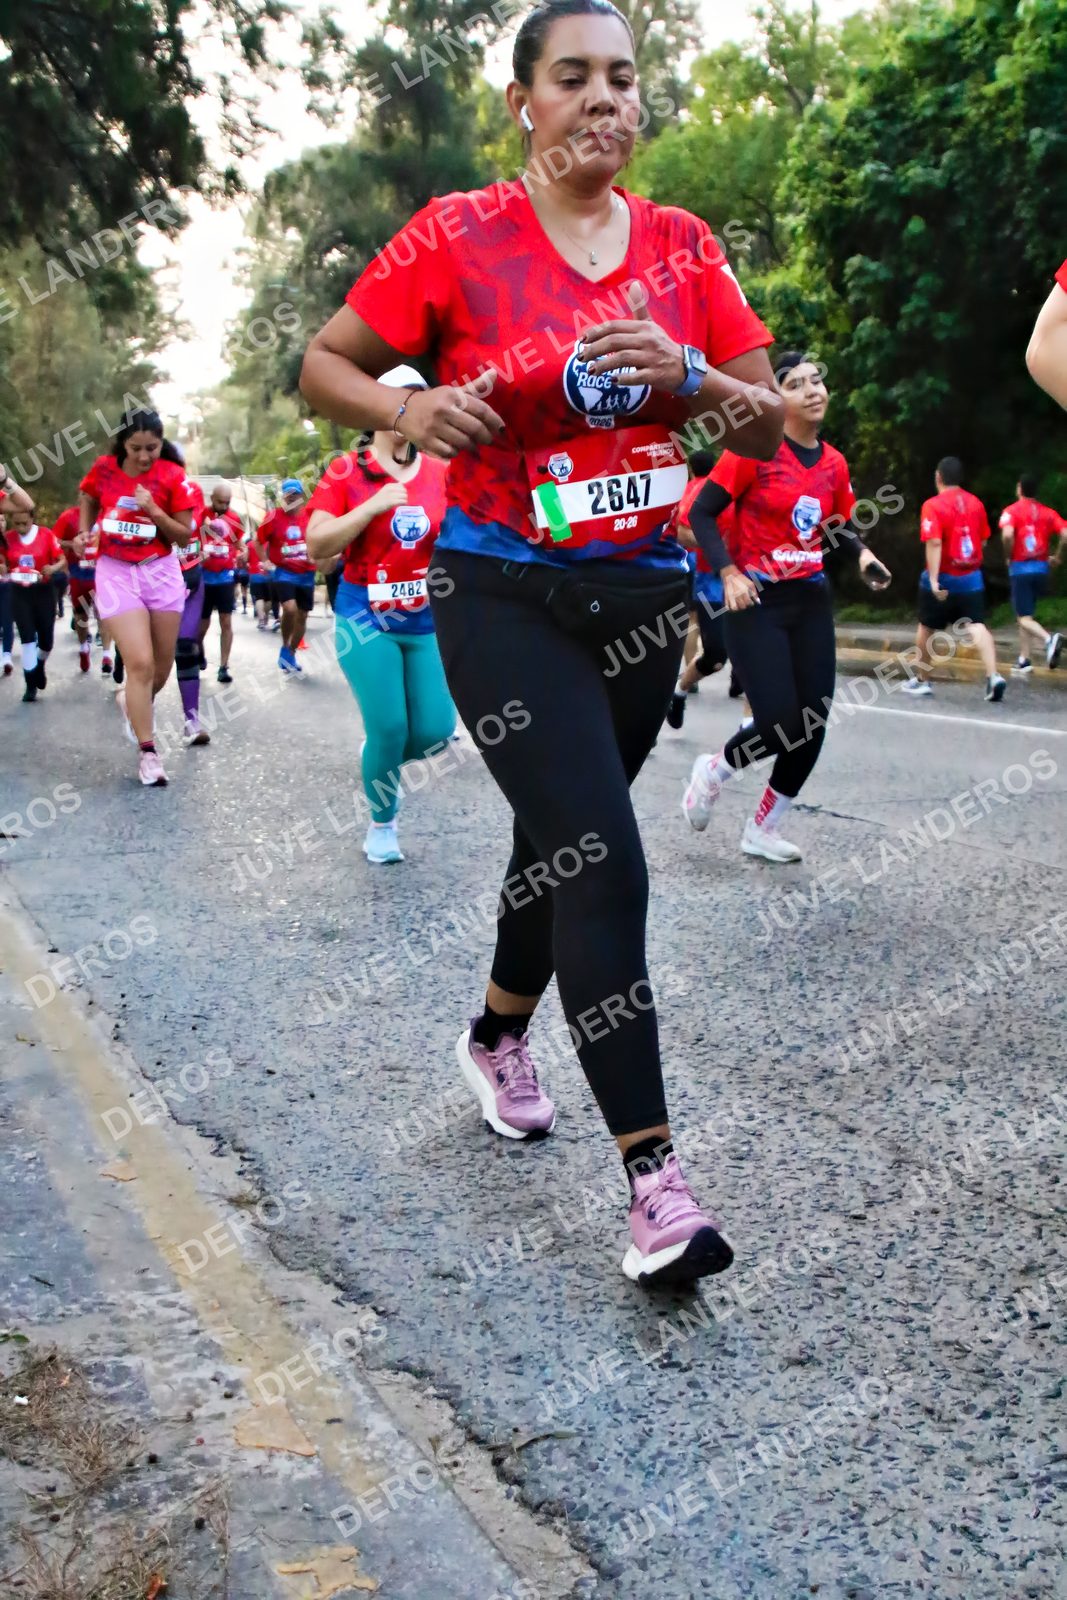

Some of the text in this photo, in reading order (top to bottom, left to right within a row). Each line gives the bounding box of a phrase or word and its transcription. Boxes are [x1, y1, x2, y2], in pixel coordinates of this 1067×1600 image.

[577, 372, 612, 389] Race
[588, 473, 650, 515] 2647
[118, 522, 140, 534] 3442
[614, 515, 638, 531] 20-26
[392, 581, 422, 598] 2482
